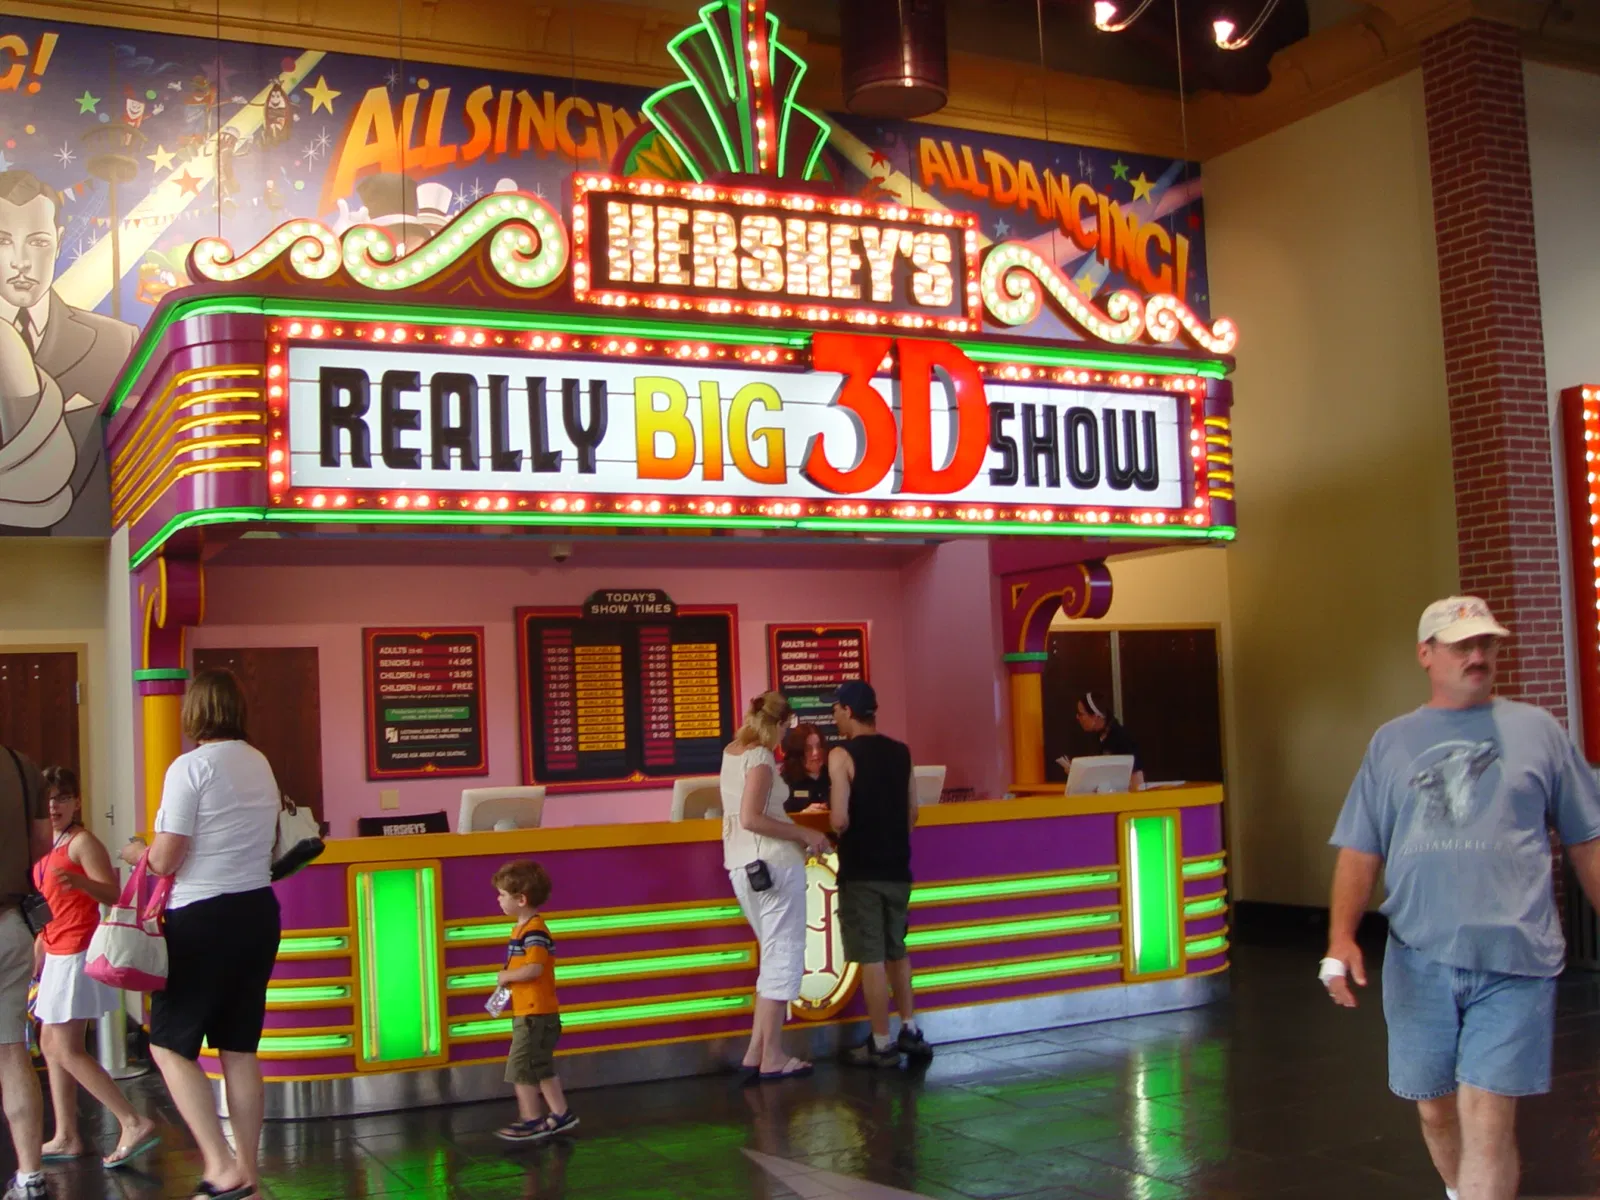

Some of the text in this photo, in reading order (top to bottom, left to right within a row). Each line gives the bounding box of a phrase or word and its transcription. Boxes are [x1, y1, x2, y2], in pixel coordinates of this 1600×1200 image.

[331, 85, 457, 204] ALL
[918, 136, 1190, 299] ALL DANCING!
[606, 200, 955, 308] HERSHEY'S
[319, 332, 1160, 494] REALLY BIG 3D SHOW
[591, 603, 672, 614] SHOW TIMES
[606, 592, 656, 602] TODAY'S
[380, 646, 407, 654] ADULTS
[380, 684, 416, 692] CHILDREN
